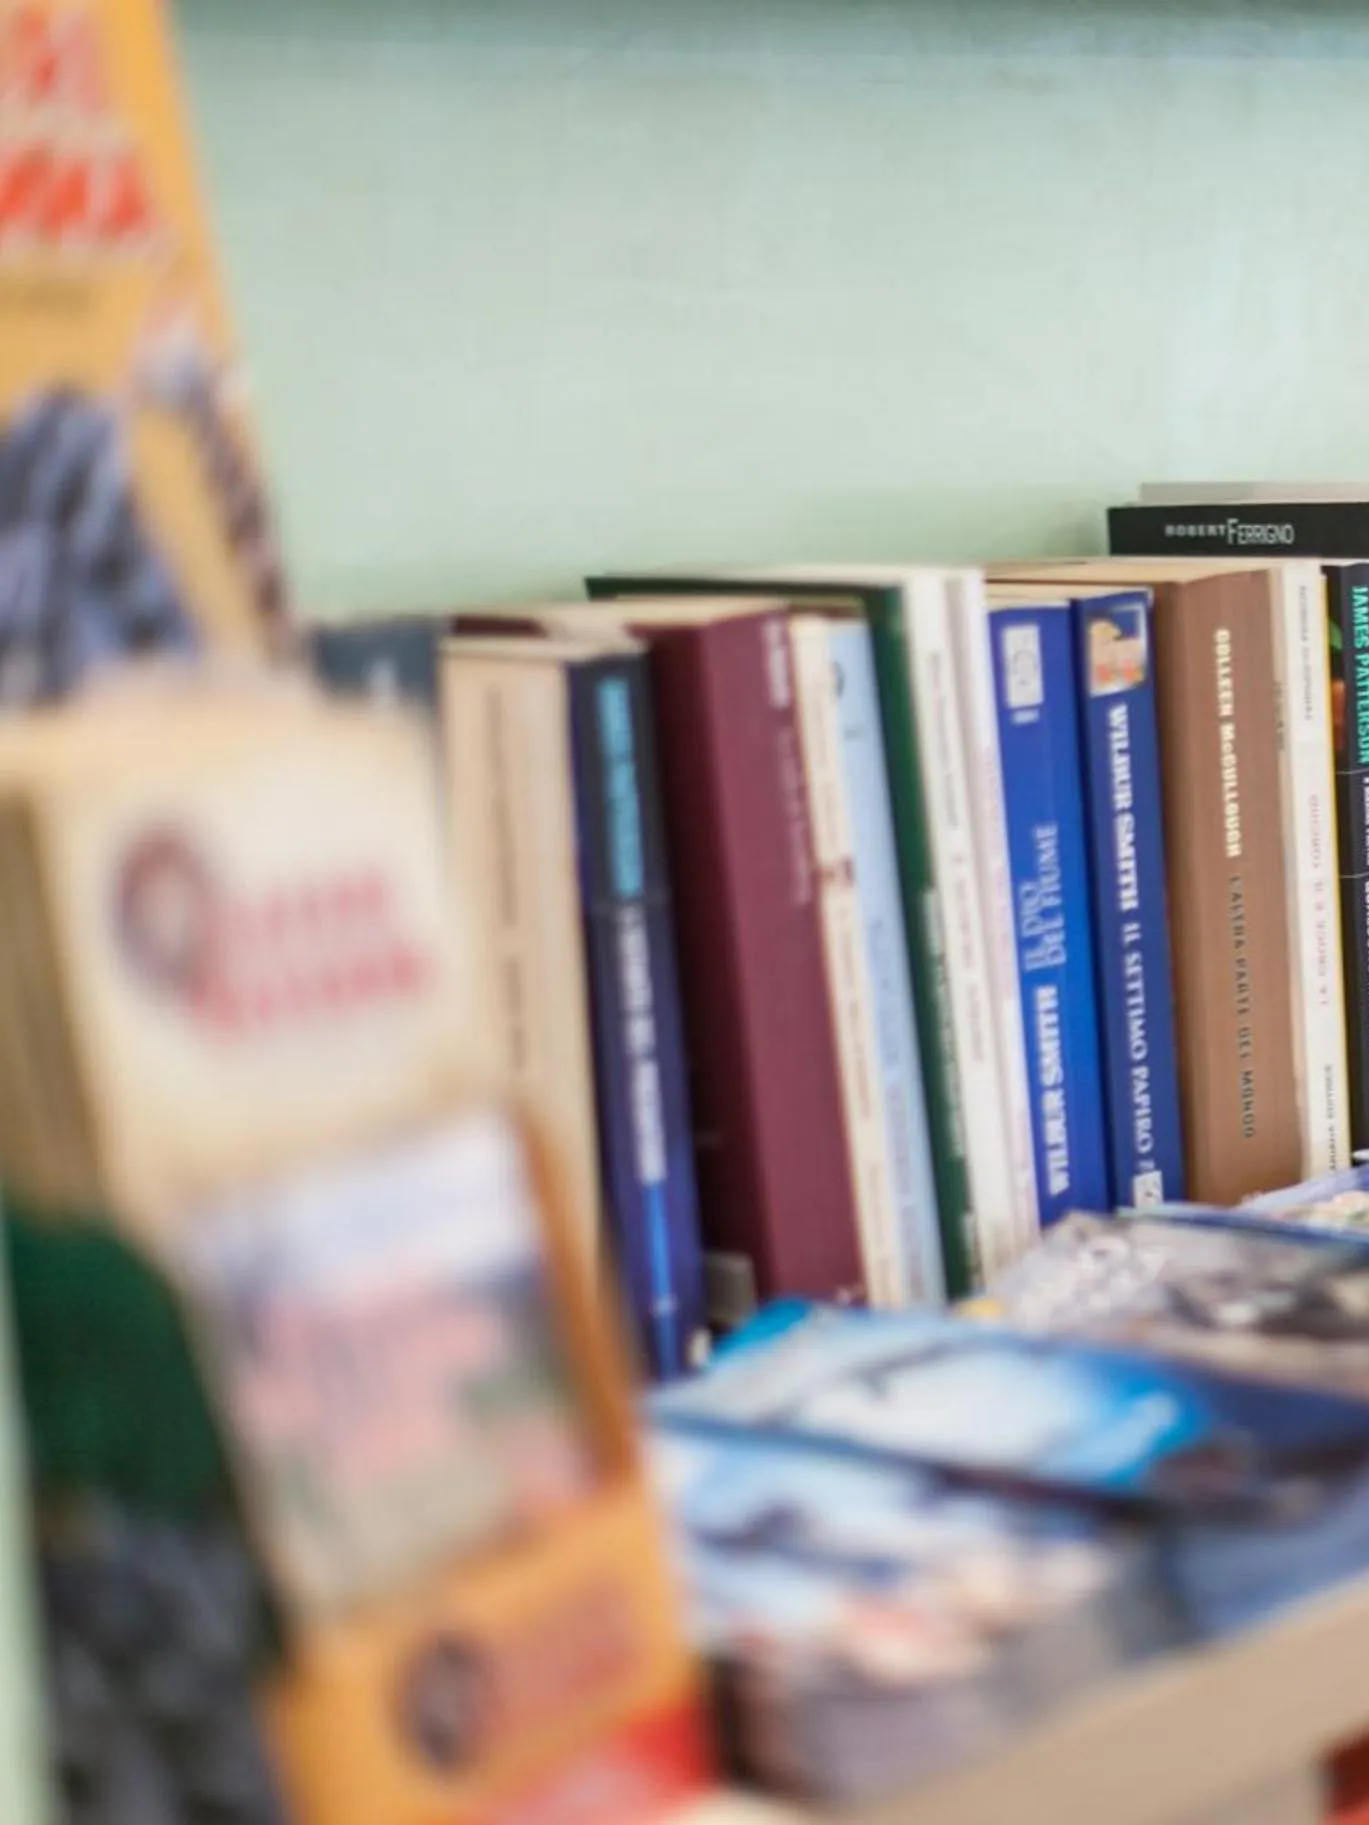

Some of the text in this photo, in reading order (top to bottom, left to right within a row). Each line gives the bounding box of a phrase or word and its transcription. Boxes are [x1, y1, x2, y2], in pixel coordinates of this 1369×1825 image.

[1164, 518, 1295, 545] ROBERT FERRIGNO
[1351, 586, 1369, 648] JAMES
[1215, 628, 1234, 717] COLLEEN
[1218, 723, 1242, 858] McCULLOUGH
[1108, 704, 1154, 1154] WILBUR SMITH IL SETTIMO PAPIRO
[1034, 985, 1070, 1196] WILBUR SMITH
[1239, 1070, 1256, 1139] MONDO
